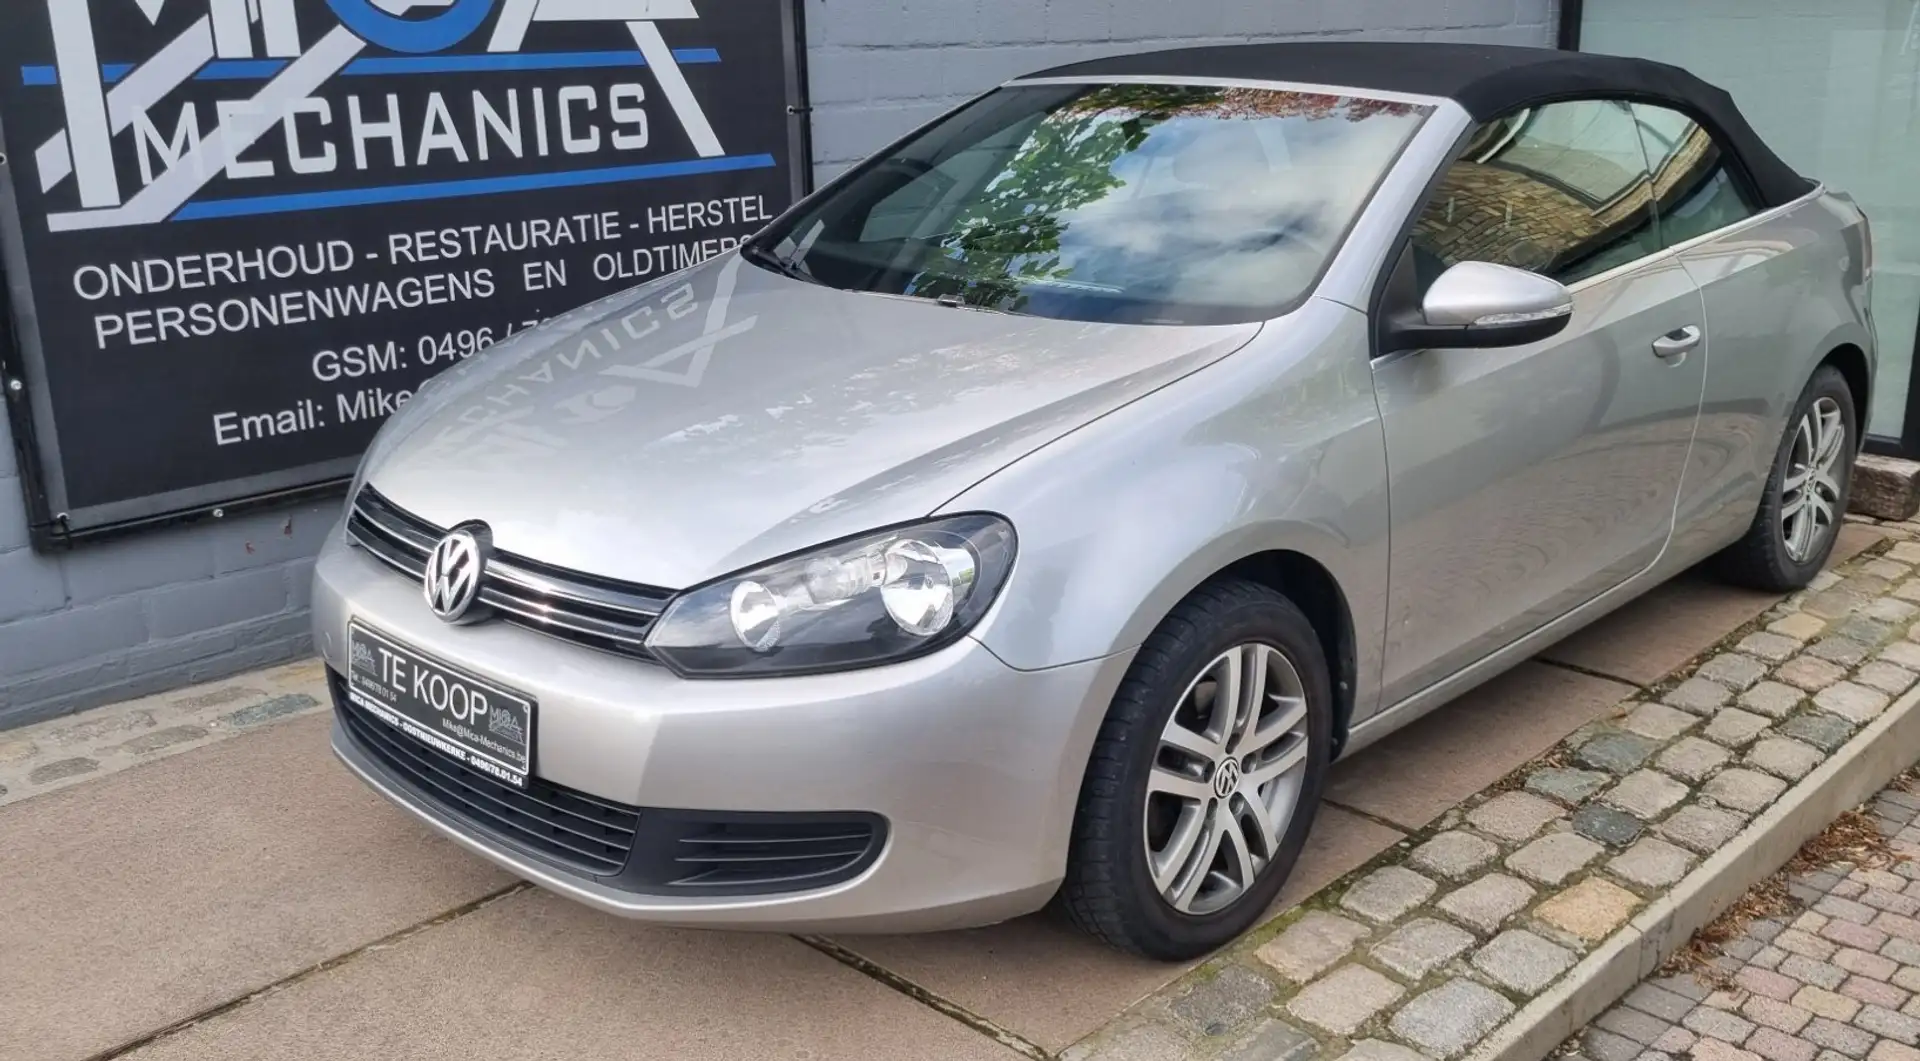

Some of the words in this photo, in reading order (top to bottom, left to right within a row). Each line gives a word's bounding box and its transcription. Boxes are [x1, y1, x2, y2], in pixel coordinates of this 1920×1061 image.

[132, 83, 649, 186] MECHANICS
[73, 240, 354, 300] ONDERHOUD
[389, 211, 622, 265] RESTAURATIE
[648, 195, 773, 233] HERSTEL
[95, 268, 495, 349] PERSONENWAGENS
[523, 259, 567, 291] EN
[312, 341, 407, 382] GSM:
[418, 327, 494, 365] 0496
[213, 399, 325, 446] Email:
[365, 699, 399, 726] MECHANICS
[378, 647, 406, 693] TE
[414, 665, 488, 726] KOOP
